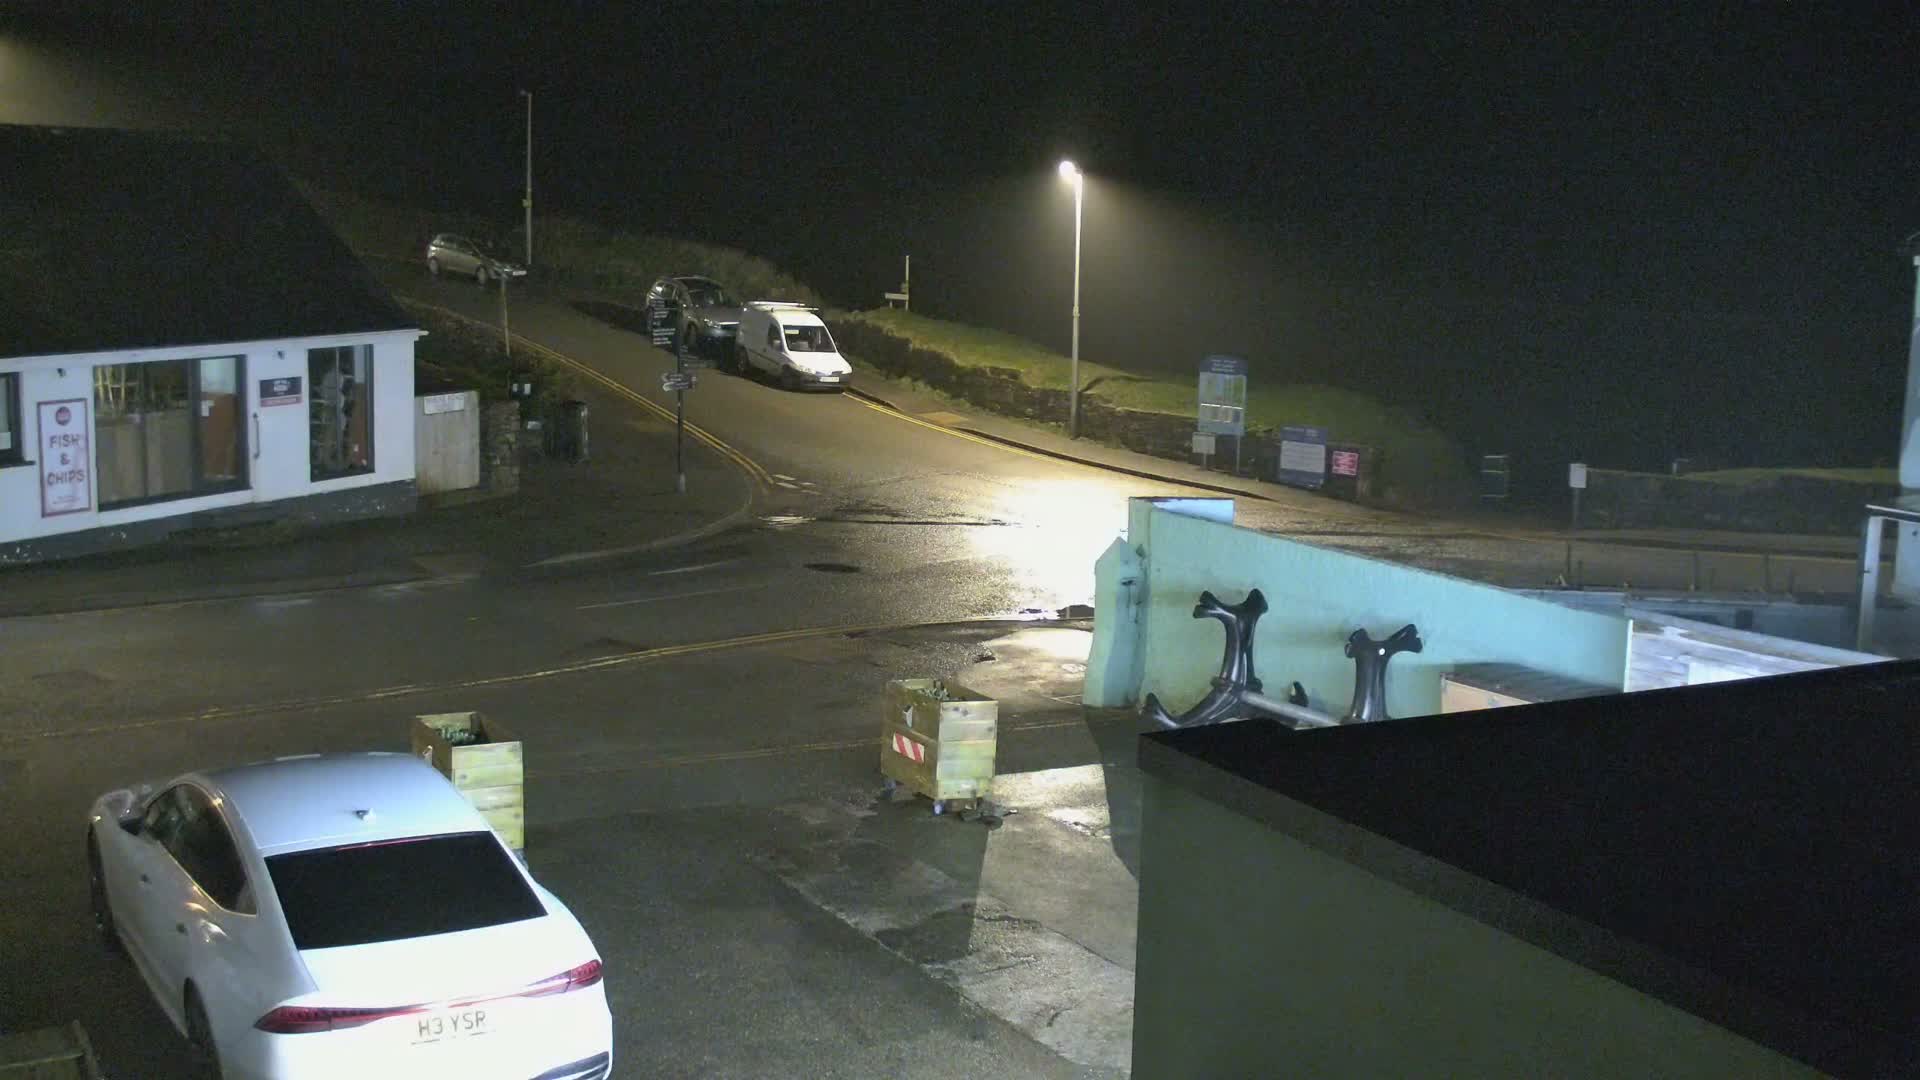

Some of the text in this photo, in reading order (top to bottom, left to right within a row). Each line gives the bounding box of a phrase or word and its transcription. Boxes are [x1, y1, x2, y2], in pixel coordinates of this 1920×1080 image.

[49, 433, 80, 448] FISH
[60, 453, 71, 466] &
[47, 469, 85, 486] CHIPS
[418, 1010, 487, 1037] H3 YSR
